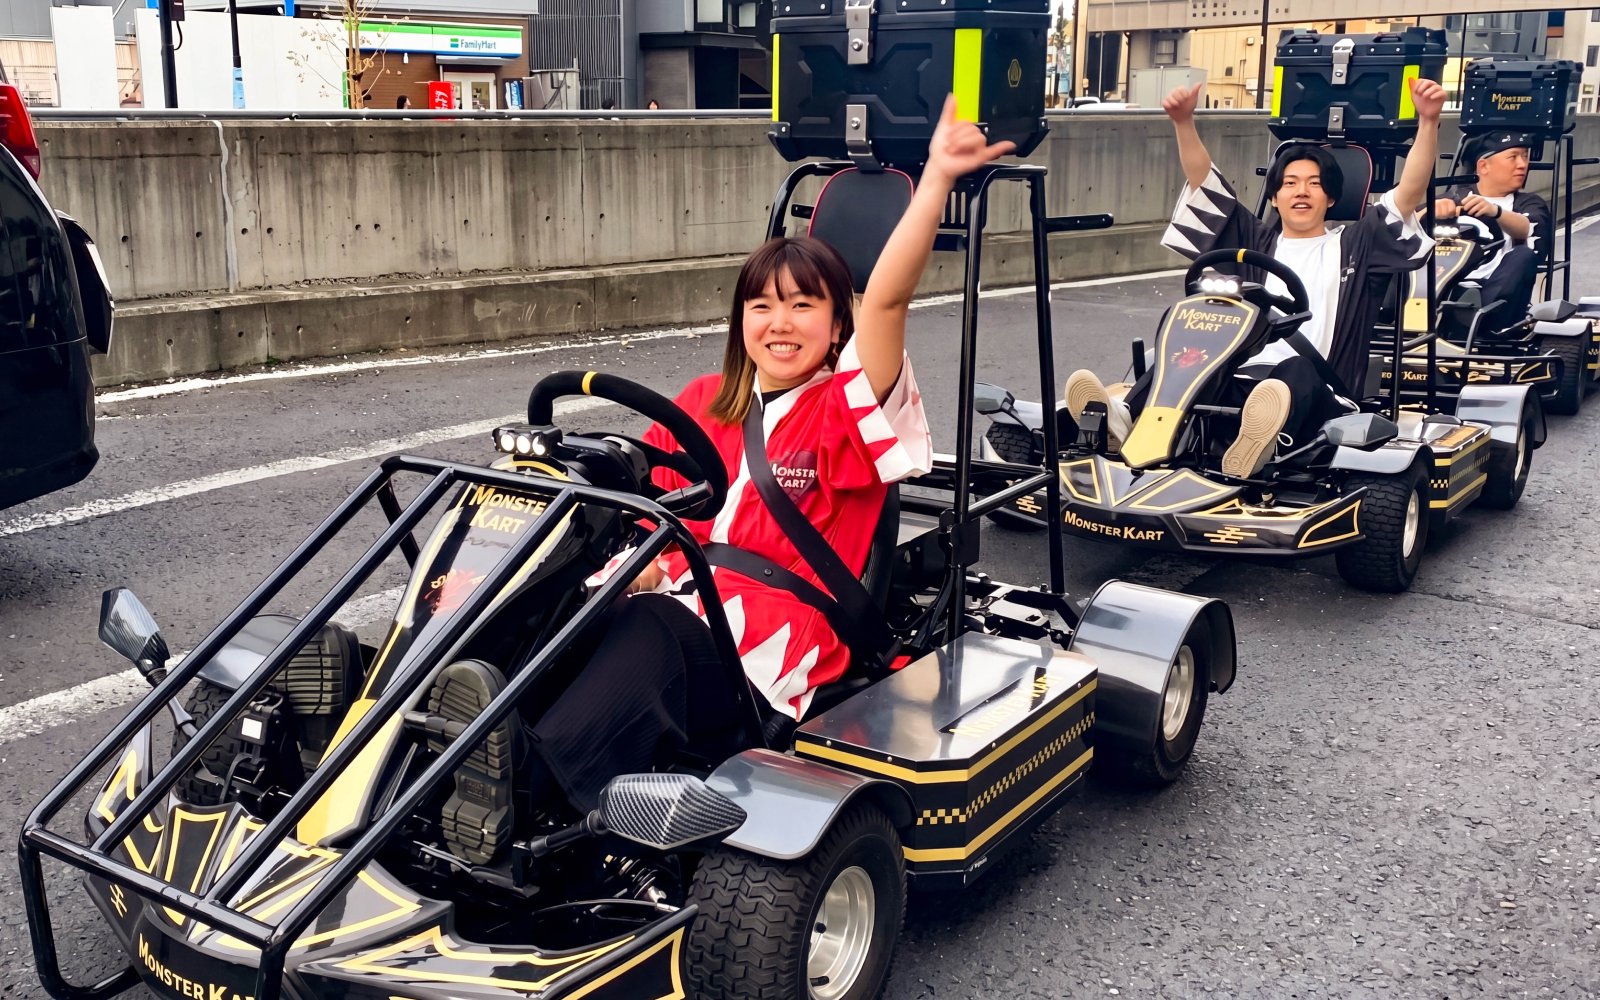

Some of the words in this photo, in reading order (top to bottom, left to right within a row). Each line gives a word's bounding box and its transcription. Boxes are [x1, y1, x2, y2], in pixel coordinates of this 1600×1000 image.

[460, 39, 496, 50] FamilyMart
[1492, 93, 1531, 102] MONSTER
[1178, 309, 1241, 324] MONSTER
[1184, 320, 1221, 331] KART
[469, 485, 546, 516] MONSTE
[469, 507, 525, 534] KART
[1065, 510, 1121, 537] MONSTER
[1123, 526, 1164, 540] KART
[139, 932, 204, 1000] MONSTER
